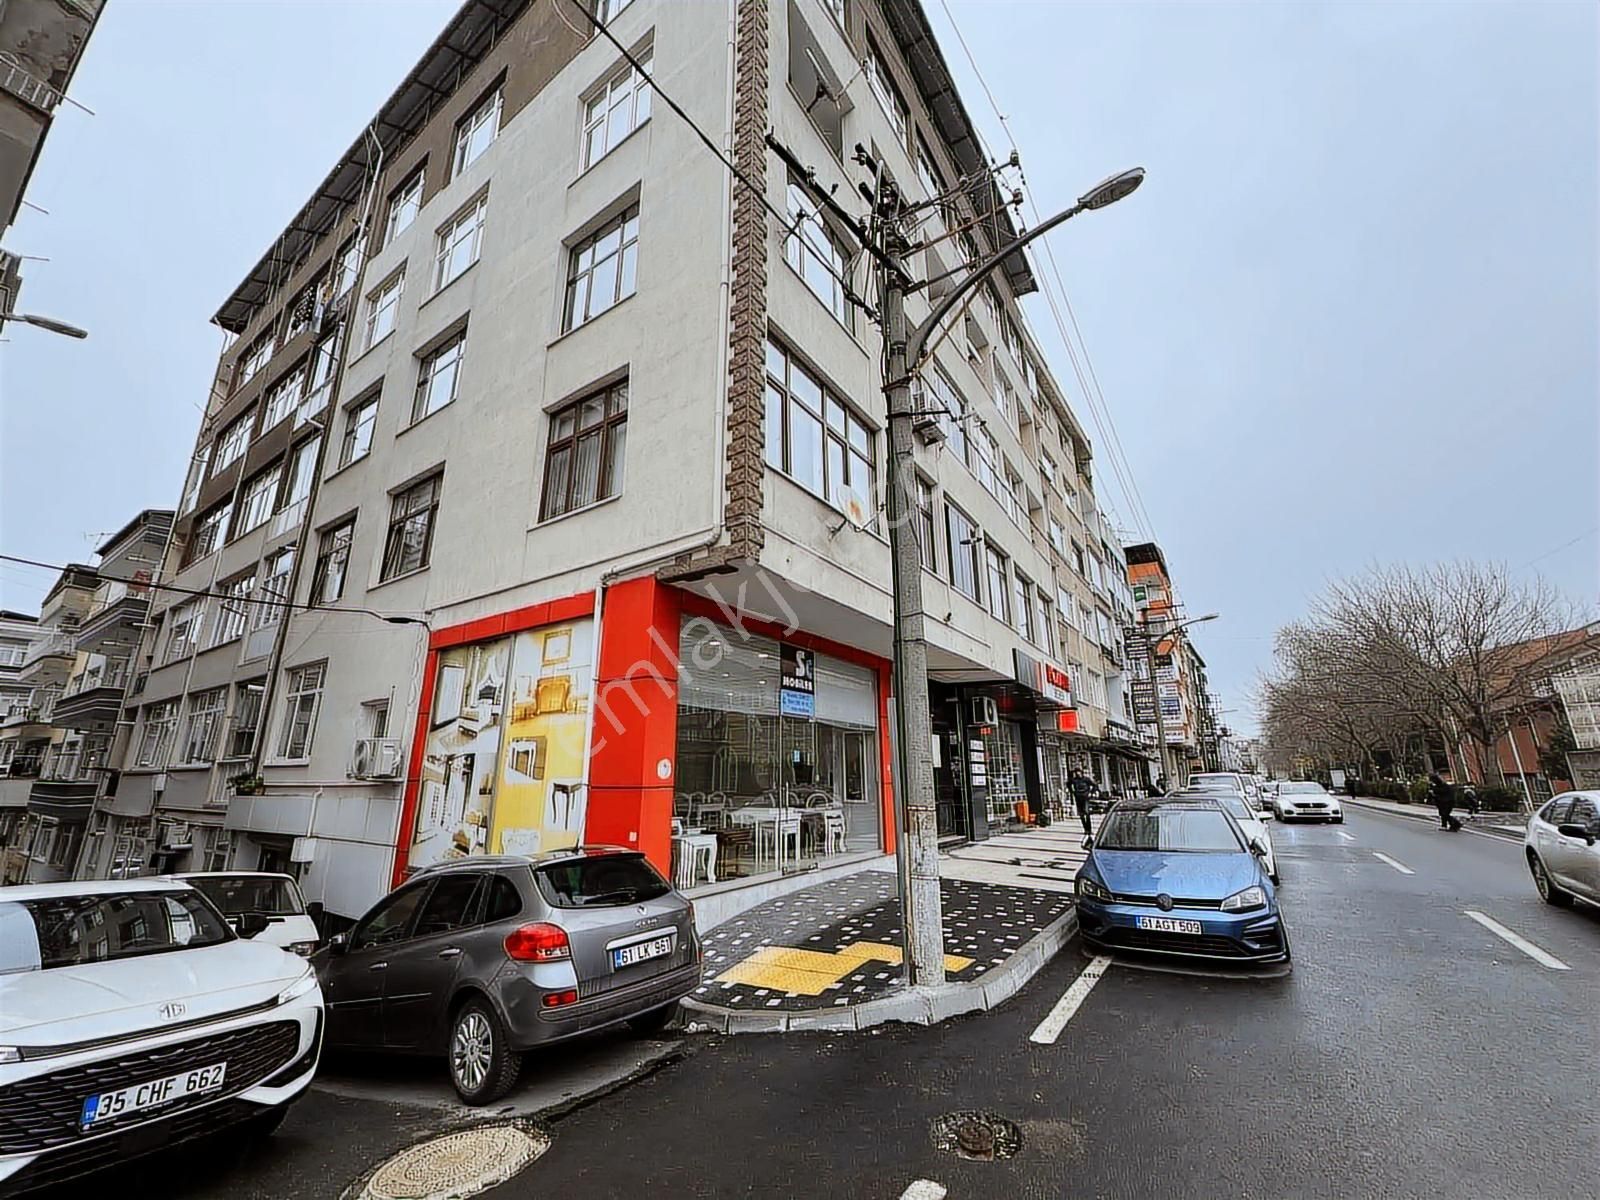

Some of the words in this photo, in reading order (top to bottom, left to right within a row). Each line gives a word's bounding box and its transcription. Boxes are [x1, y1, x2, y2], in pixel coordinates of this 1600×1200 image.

[1141, 917, 1153, 929] 61
[1155, 919, 1177, 931] AGT
[1179, 921, 1200, 933] 509
[621, 949, 633, 964] 61
[637, 943, 651, 959] LK
[654, 938, 669, 954] 961
[97, 1091, 126, 1117] 35
[135, 1078, 176, 1107] CHF
[186, 1065, 223, 1093] 662
